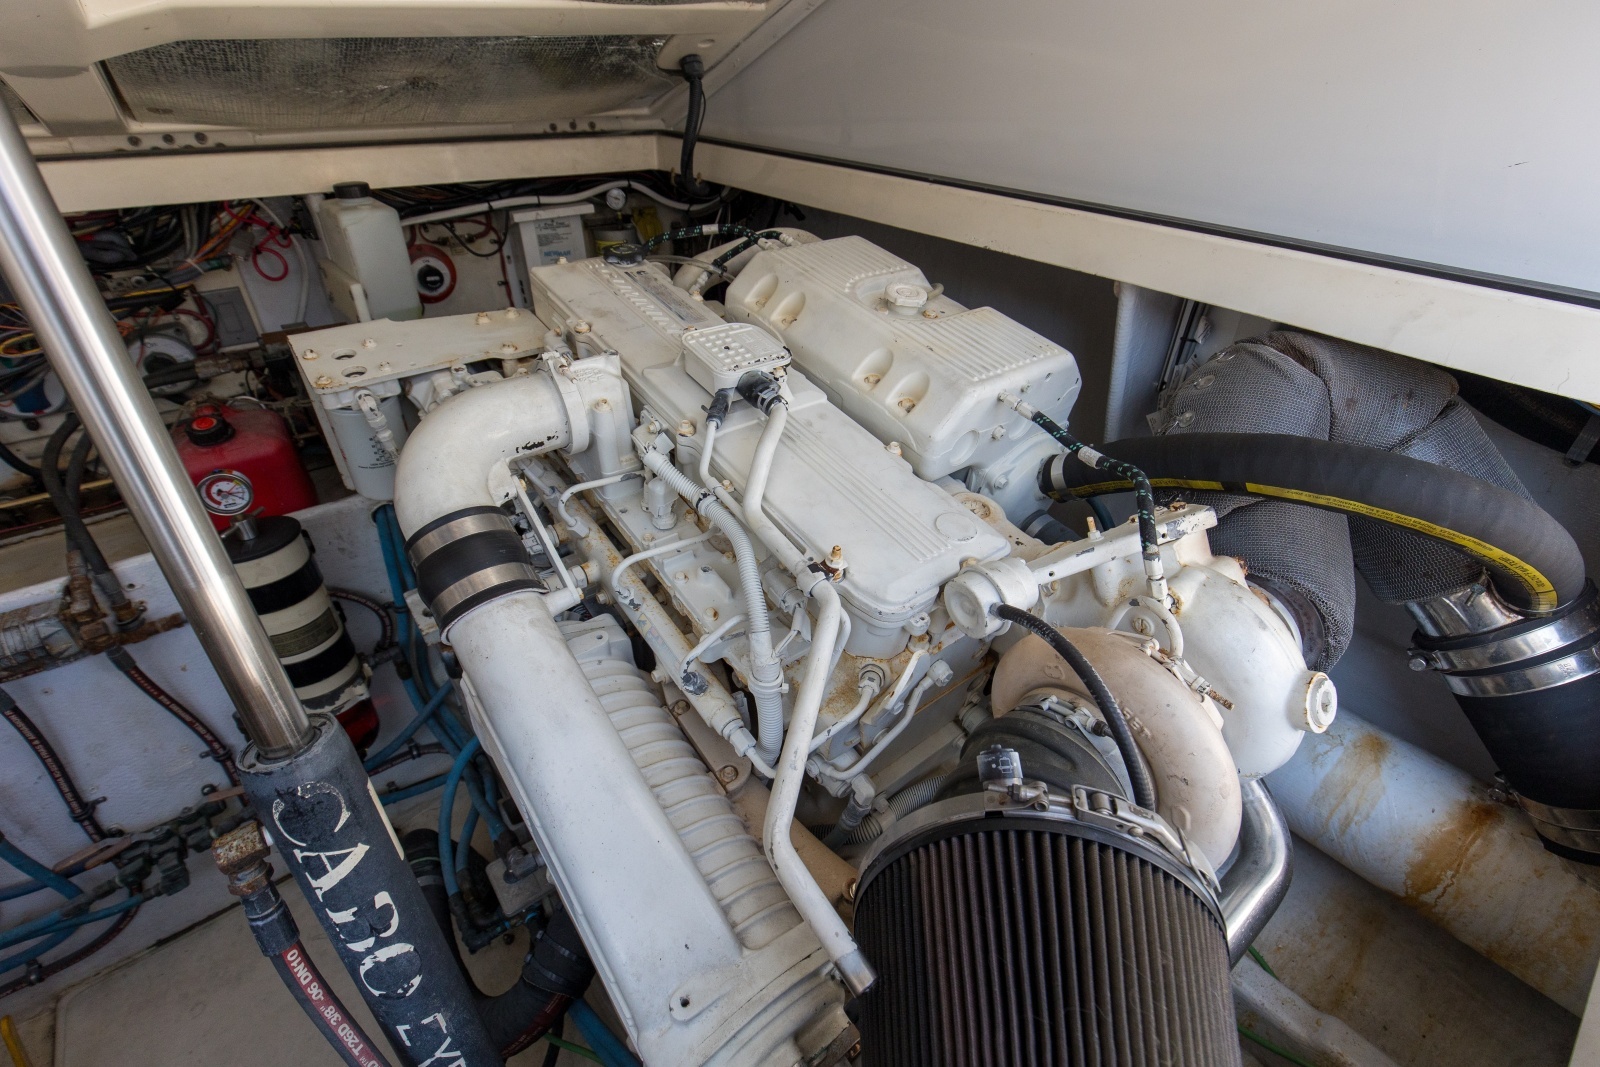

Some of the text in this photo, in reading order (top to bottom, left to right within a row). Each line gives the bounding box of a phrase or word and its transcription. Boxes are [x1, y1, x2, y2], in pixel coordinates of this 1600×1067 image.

[272, 781, 422, 998] CABO
[286, 949, 312, 986] DN10
[308, 982, 324, 1001] -06
[320, 1005, 342, 1026] 3/8"
[338, 1022, 364, 1056] T26D
